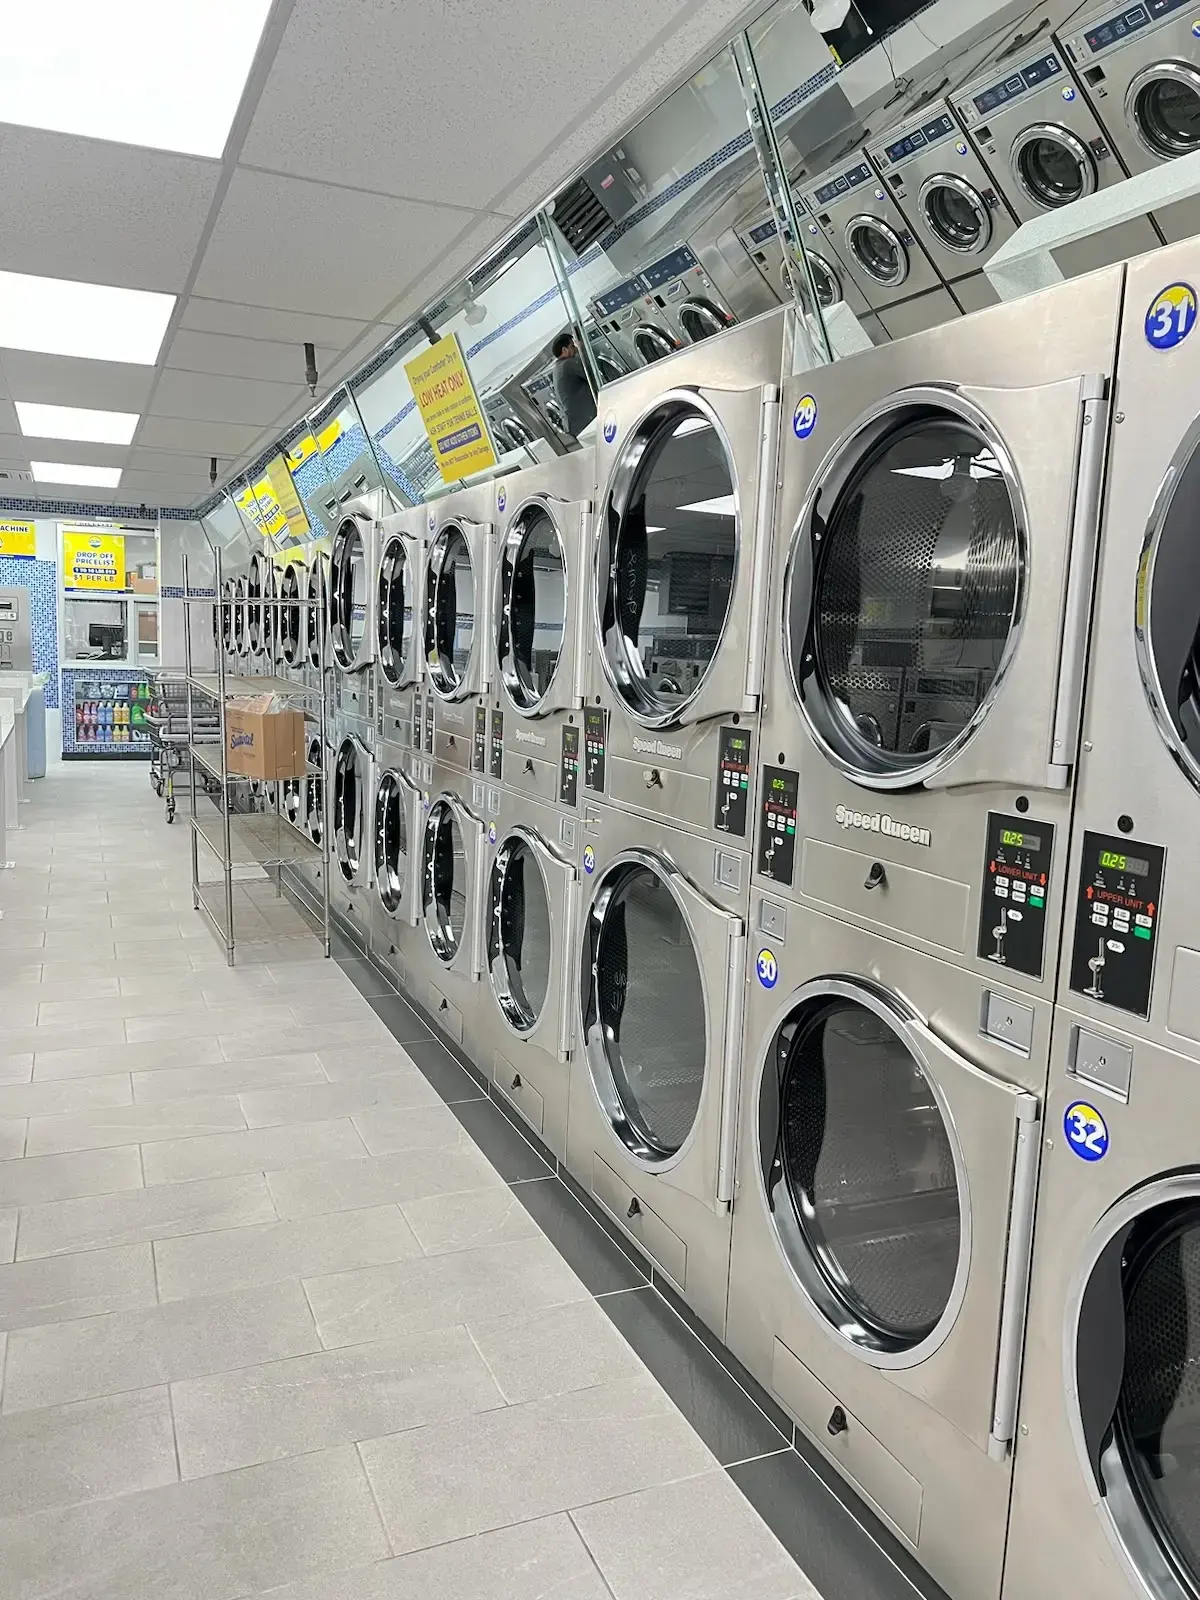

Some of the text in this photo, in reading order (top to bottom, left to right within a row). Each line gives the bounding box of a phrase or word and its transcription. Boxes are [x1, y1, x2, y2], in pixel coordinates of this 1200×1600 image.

[1153, 295, 1189, 338] 31
[419, 391, 433, 408] LOW
[433, 380, 448, 400] HEAT
[448, 369, 465, 392] ONLY
[796, 405, 814, 431] 29
[76, 558, 114, 566] PRICELIST
[633, 736, 682, 760] Speed Queen
[836, 804, 932, 848] Speed Queen
[1003, 830, 1023, 846] 0.25
[1102, 852, 1126, 869] 0.25
[998, 865, 1038, 881] LOWER UNIT
[1096, 890, 1144, 910] UPPER UNIT
[760, 957, 776, 982] 30
[1070, 1110, 1102, 1154] 32
